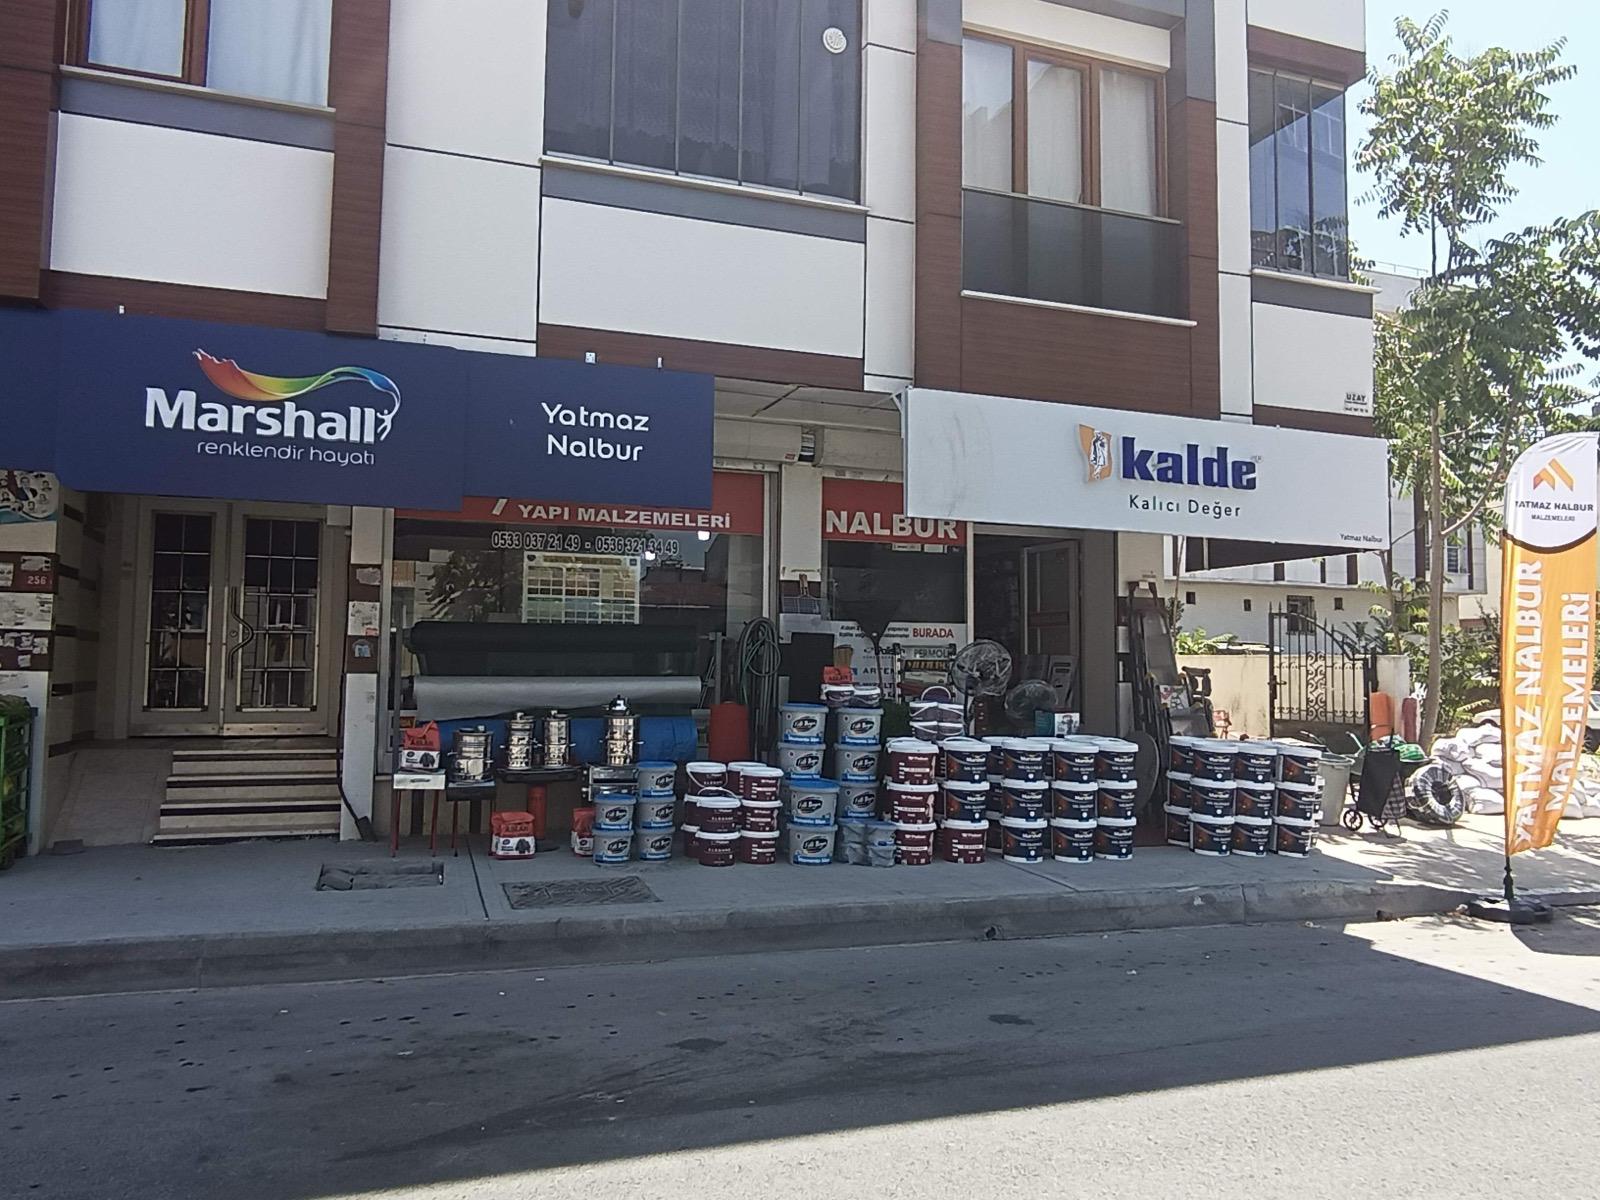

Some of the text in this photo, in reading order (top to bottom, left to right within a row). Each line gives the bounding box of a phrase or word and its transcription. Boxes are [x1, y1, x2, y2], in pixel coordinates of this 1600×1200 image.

[145, 387, 375, 444] Marshall
[541, 402, 650, 432] Yatmaz
[197, 440, 375, 466] renklendir hayatı
[547, 434, 644, 462] Nalbur
[1121, 436, 1257, 490] kalde
[518, 504, 570, 521] YAPI
[1129, 495, 1241, 519] Kalıcı Değer
[1554, 503, 1594, 512] NALBUR
[825, 509, 958, 540] NALBUR
[492, 531, 521, 548] 0533
[524, 532, 546, 549] 037
[548, 534, 562, 549] 21
[565, 534, 581, 550] 49
[596, 536, 624, 552] 0536
[625, 537, 646, 553] 321
[27, 575, 47, 585] 256
[912, 627, 955, 638] BURADA
[1514, 560, 1544, 845] YATMAZ NALBUR
